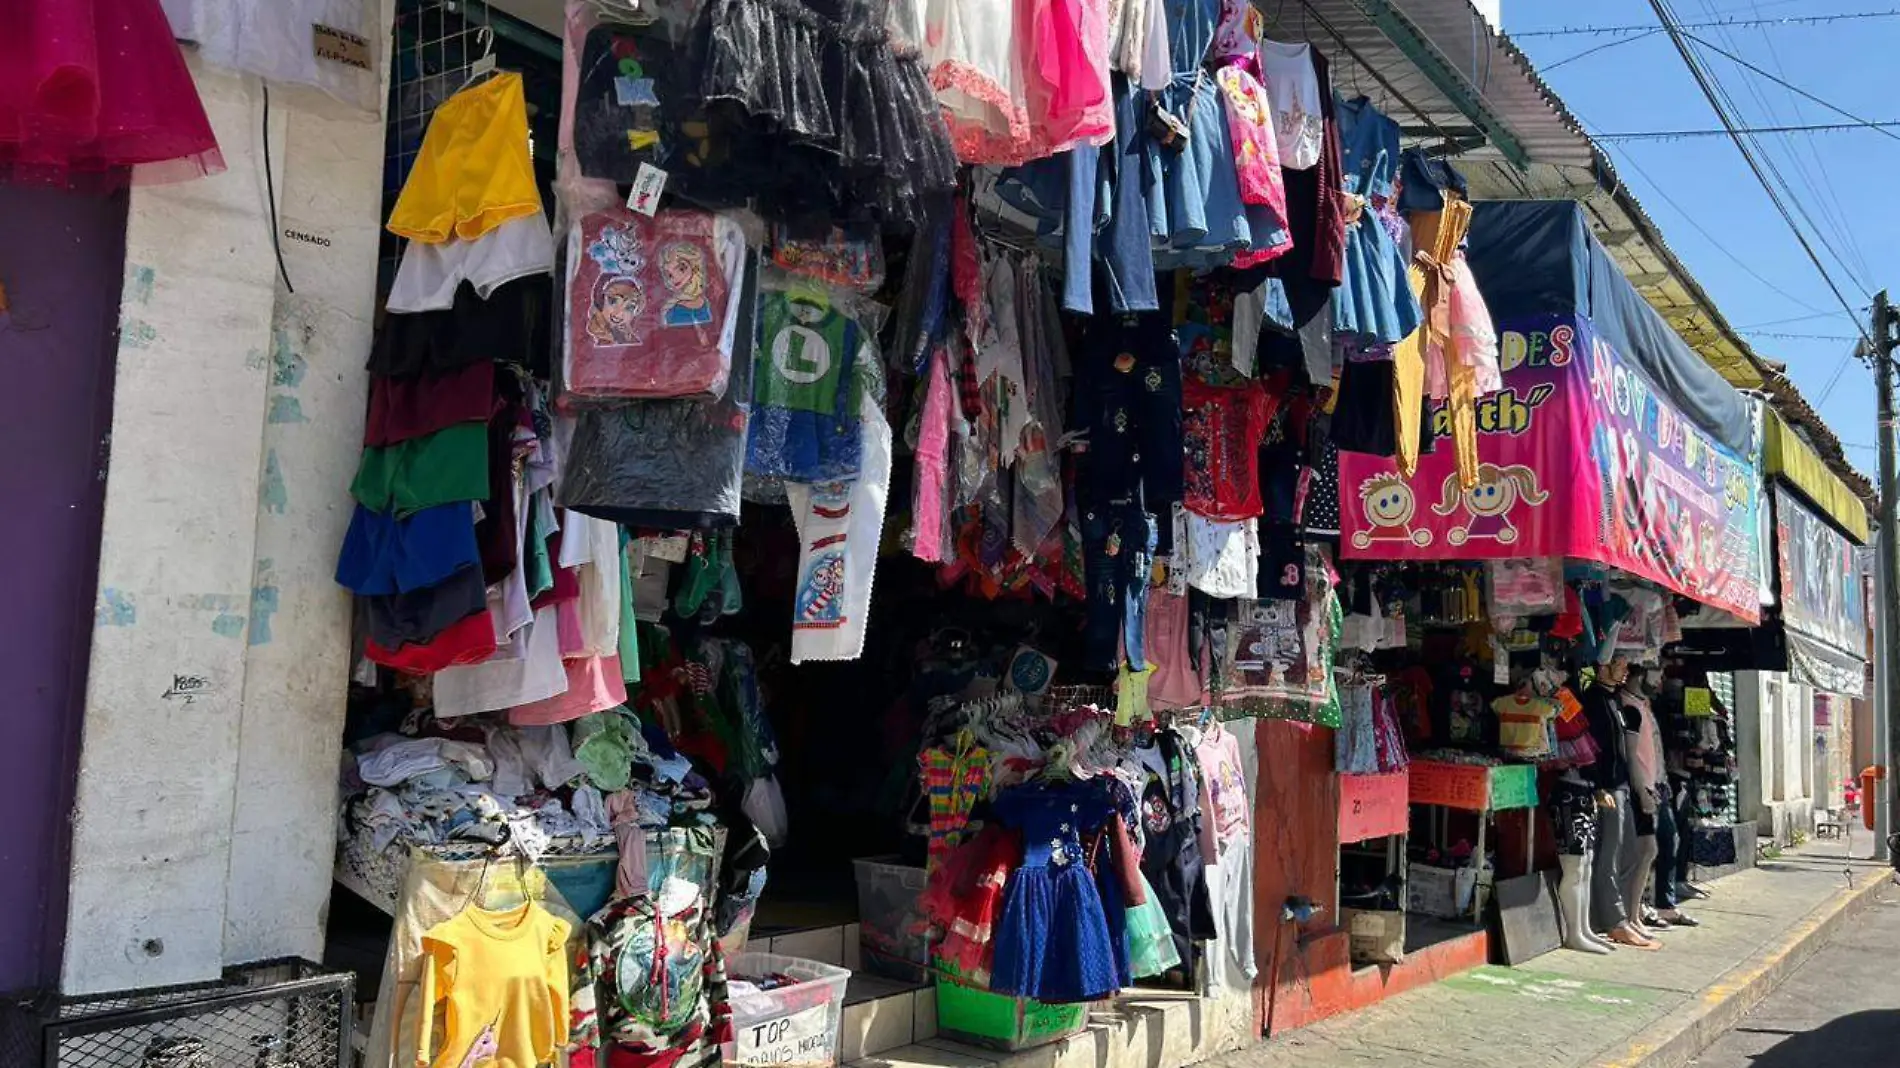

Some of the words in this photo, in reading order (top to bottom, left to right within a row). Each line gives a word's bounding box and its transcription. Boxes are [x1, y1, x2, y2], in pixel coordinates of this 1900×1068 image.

[285, 229, 331, 247] CENSADO
[786, 329, 818, 375] L
[752, 1018, 790, 1048] TOP
